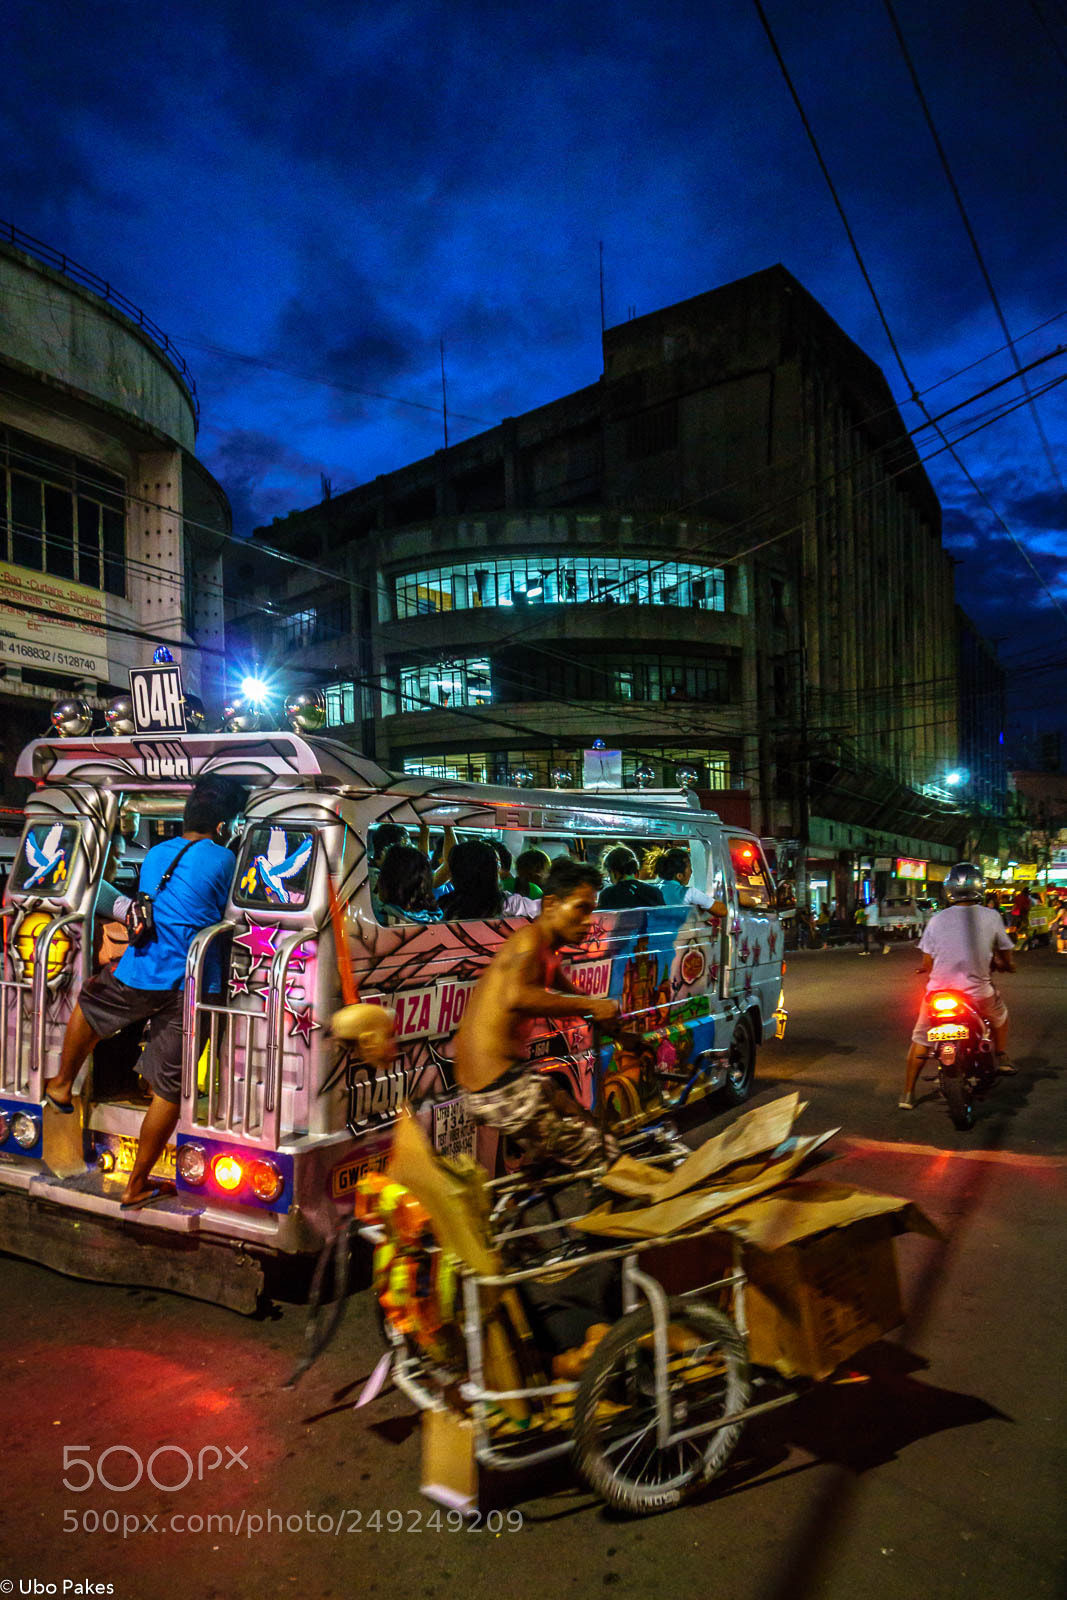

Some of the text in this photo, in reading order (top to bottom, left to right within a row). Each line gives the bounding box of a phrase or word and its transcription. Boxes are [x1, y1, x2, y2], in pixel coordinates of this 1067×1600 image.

[9, 643, 51, 661] 4168832
[58, 654, 96, 671] 5128740
[134, 673, 183, 728] 04H
[139, 743, 193, 780] 04H
